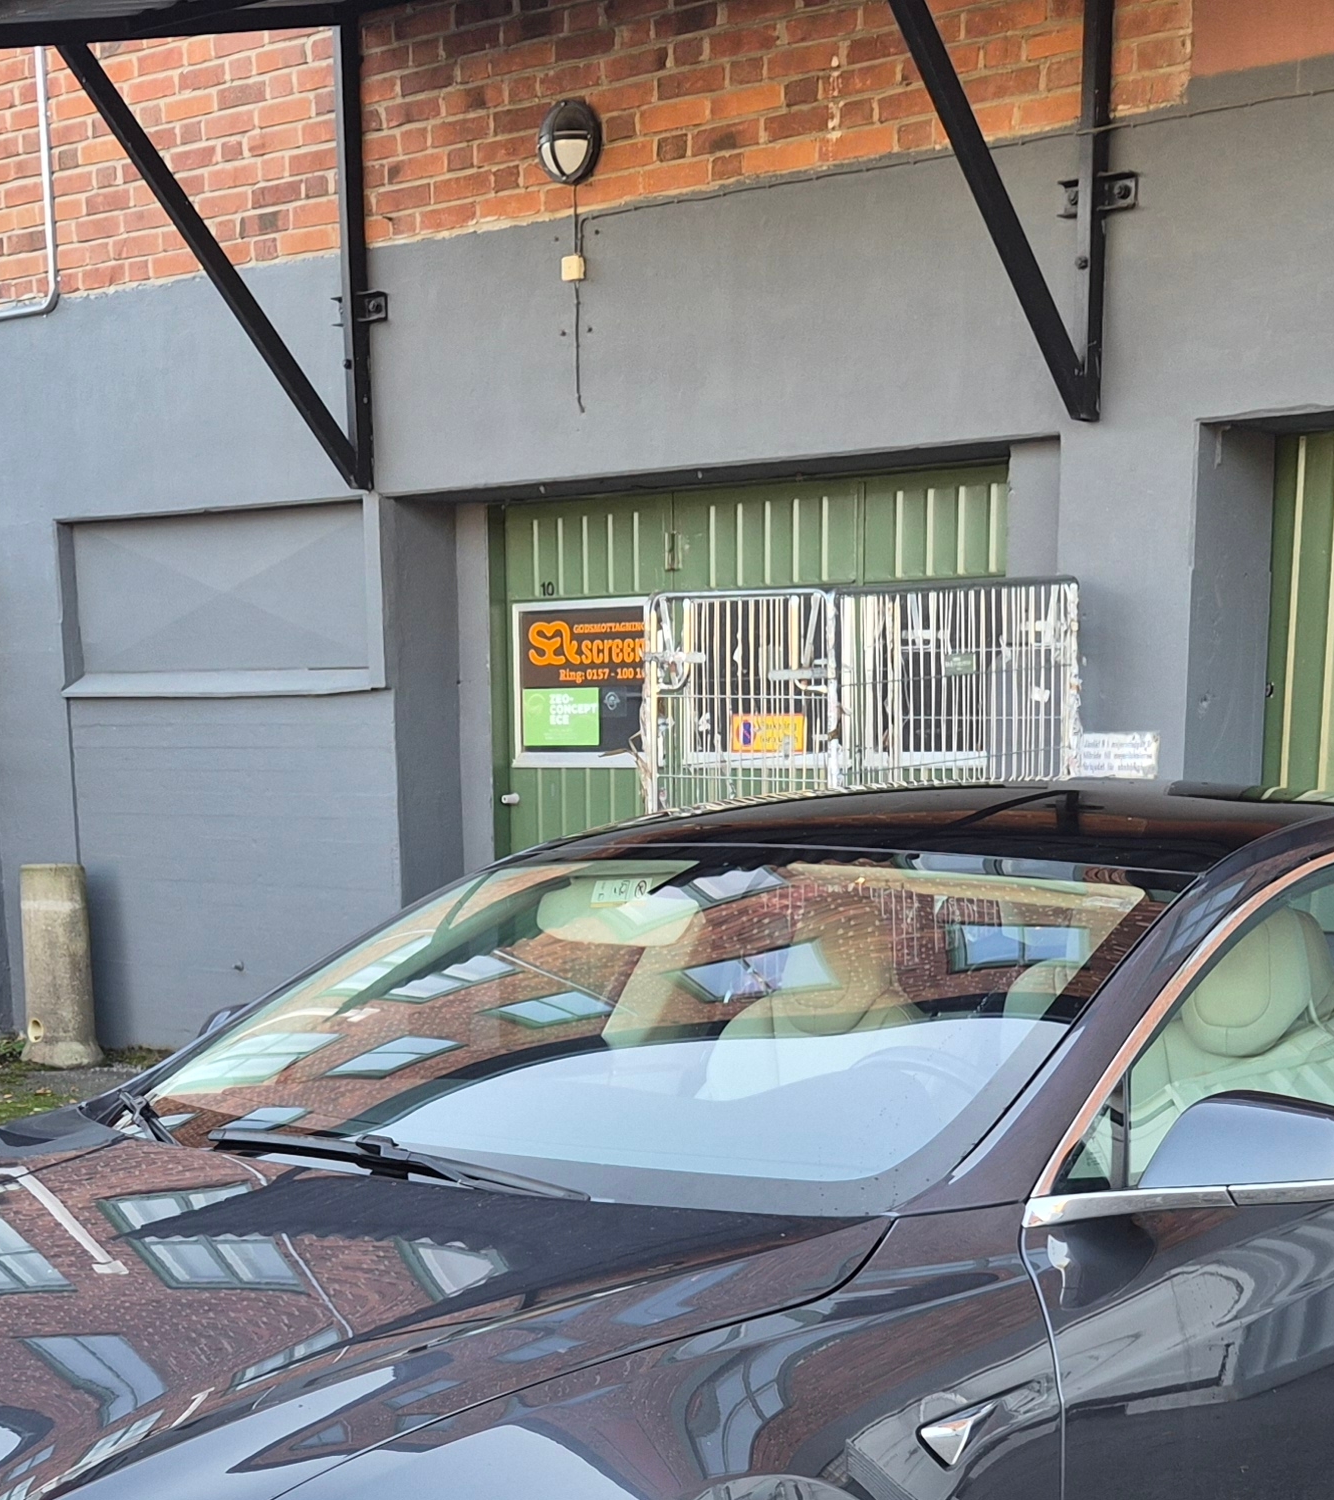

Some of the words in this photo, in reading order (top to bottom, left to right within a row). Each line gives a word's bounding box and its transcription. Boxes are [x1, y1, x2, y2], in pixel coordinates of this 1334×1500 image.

[540, 581, 555, 596] 10
[581, 637, 645, 665] screen
[559, 669, 585, 683] Ring:
[586, 669, 609, 680] 0157
[616, 668, 634, 679] 100
[549, 703, 598, 715] CONCEPT
[550, 715, 569, 725] ECE
